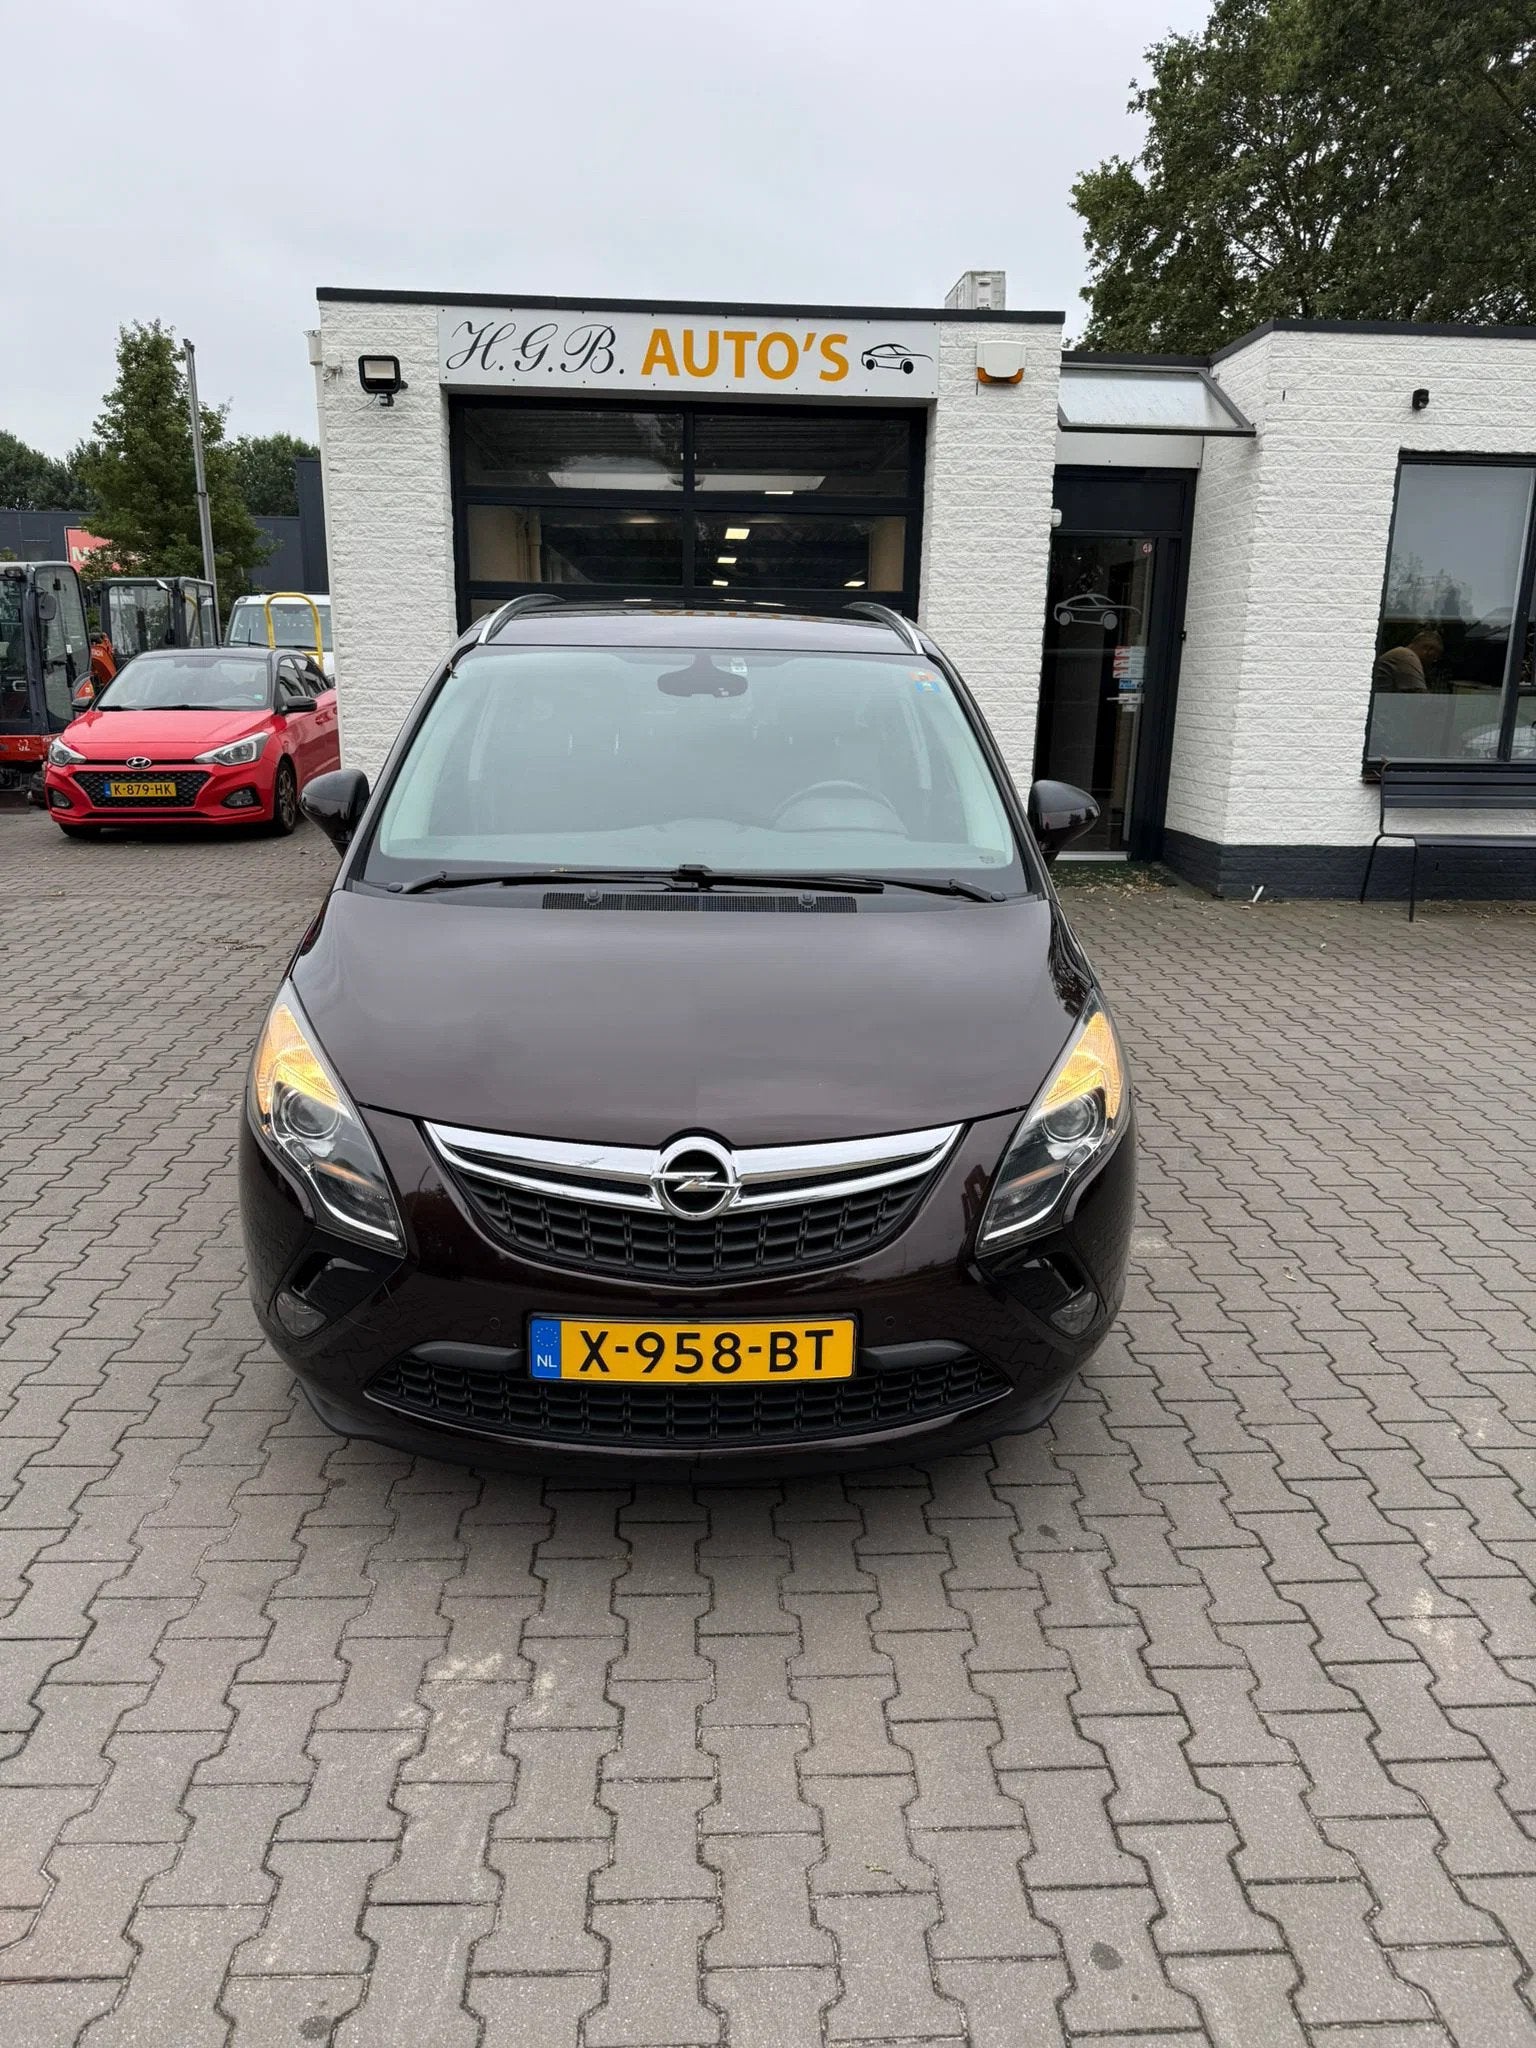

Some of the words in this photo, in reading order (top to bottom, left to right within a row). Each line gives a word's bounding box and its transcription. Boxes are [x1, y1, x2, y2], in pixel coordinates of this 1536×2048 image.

[446, 320, 624, 375] H.G.B.
[641, 328, 849, 382] AUTO'S
[114, 784, 172, 795] K-879-HK
[536, 1354, 557, 1368] NL
[579, 1329, 834, 1374] X-958-BT
